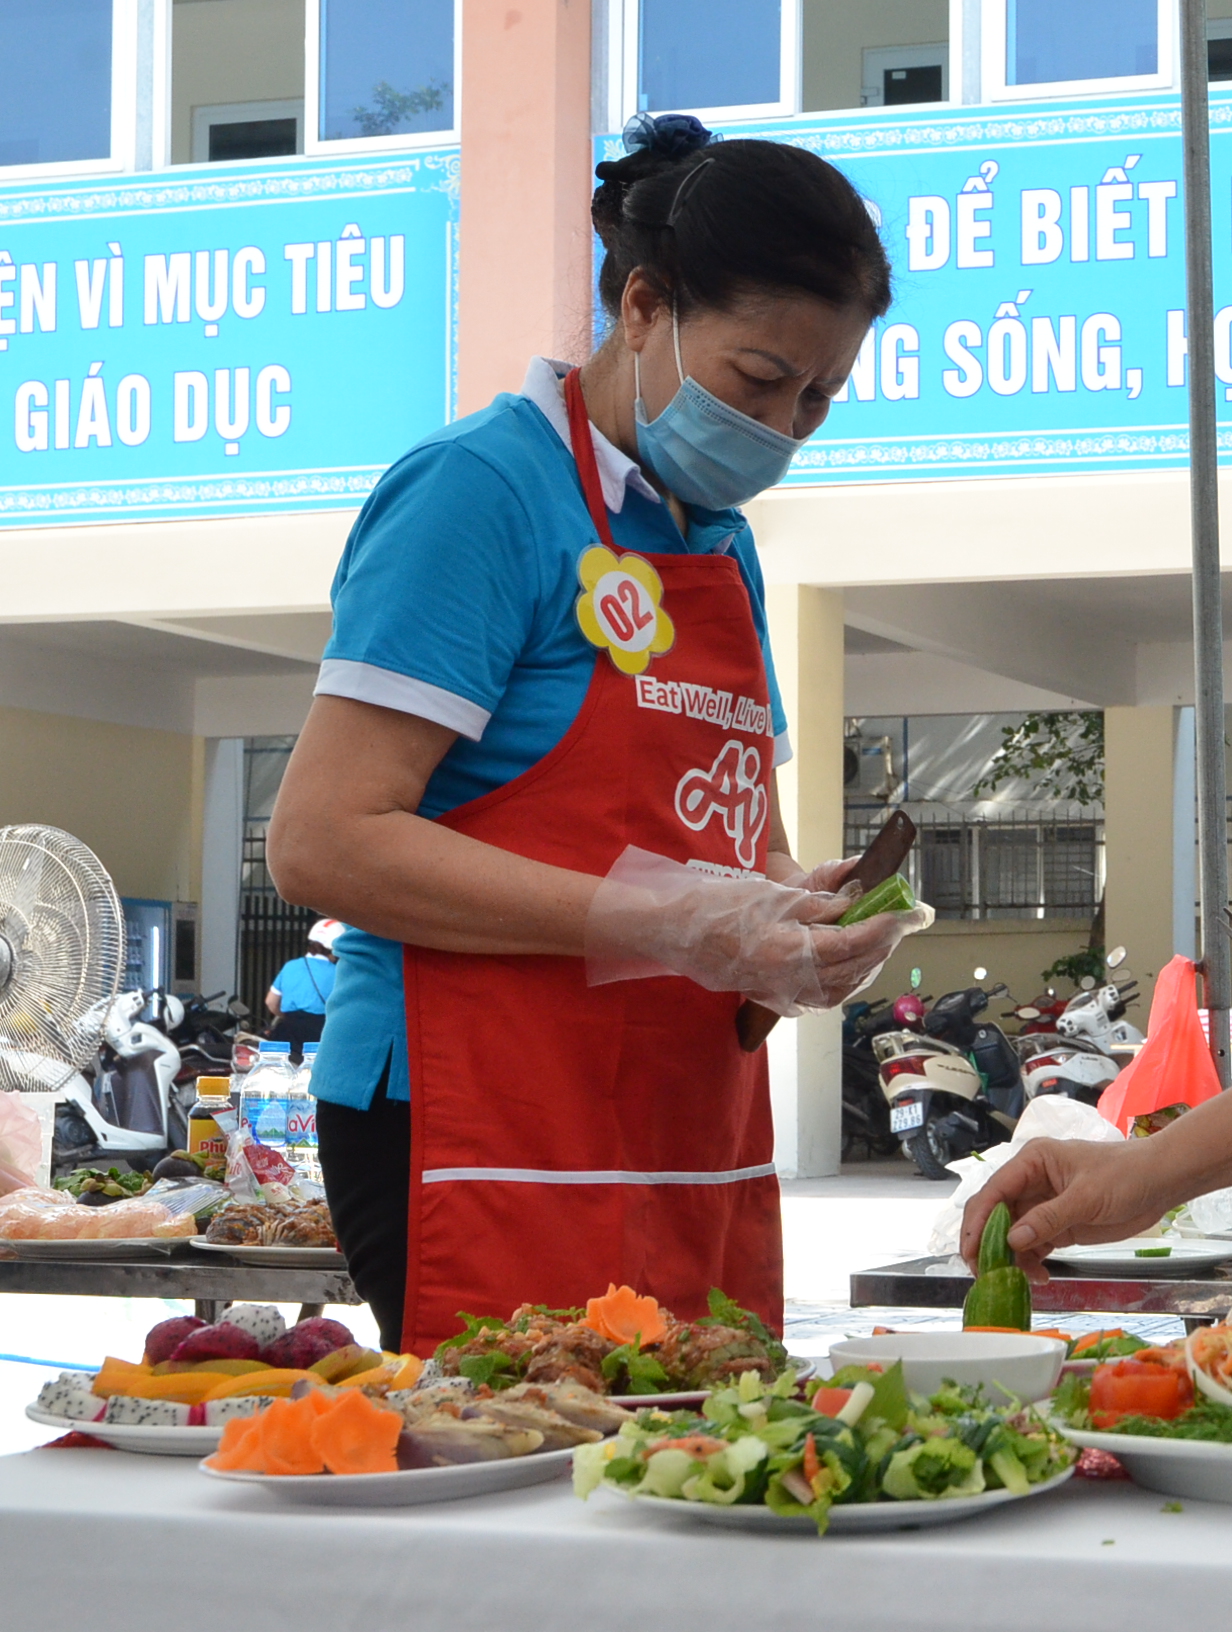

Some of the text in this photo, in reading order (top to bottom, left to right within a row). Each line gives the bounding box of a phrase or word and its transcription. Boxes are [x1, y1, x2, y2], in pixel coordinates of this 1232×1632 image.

[905, 159, 1000, 272] ĐỂ
[1020, 153, 1178, 266] BIẾT
[73, 240, 125, 331] VÌ
[143, 244, 267, 338] MỤC
[283, 222, 406, 316] TIÊU
[941, 288, 1144, 401] SỐNG,
[14, 360, 292, 456] GIÁO DỤC
[599, 578, 655, 643] 02
[637, 677, 681, 712] Eat
[682, 685, 733, 727] Well,
[733, 695, 766, 732] Live
[286, 1113, 317, 1133] aVi
